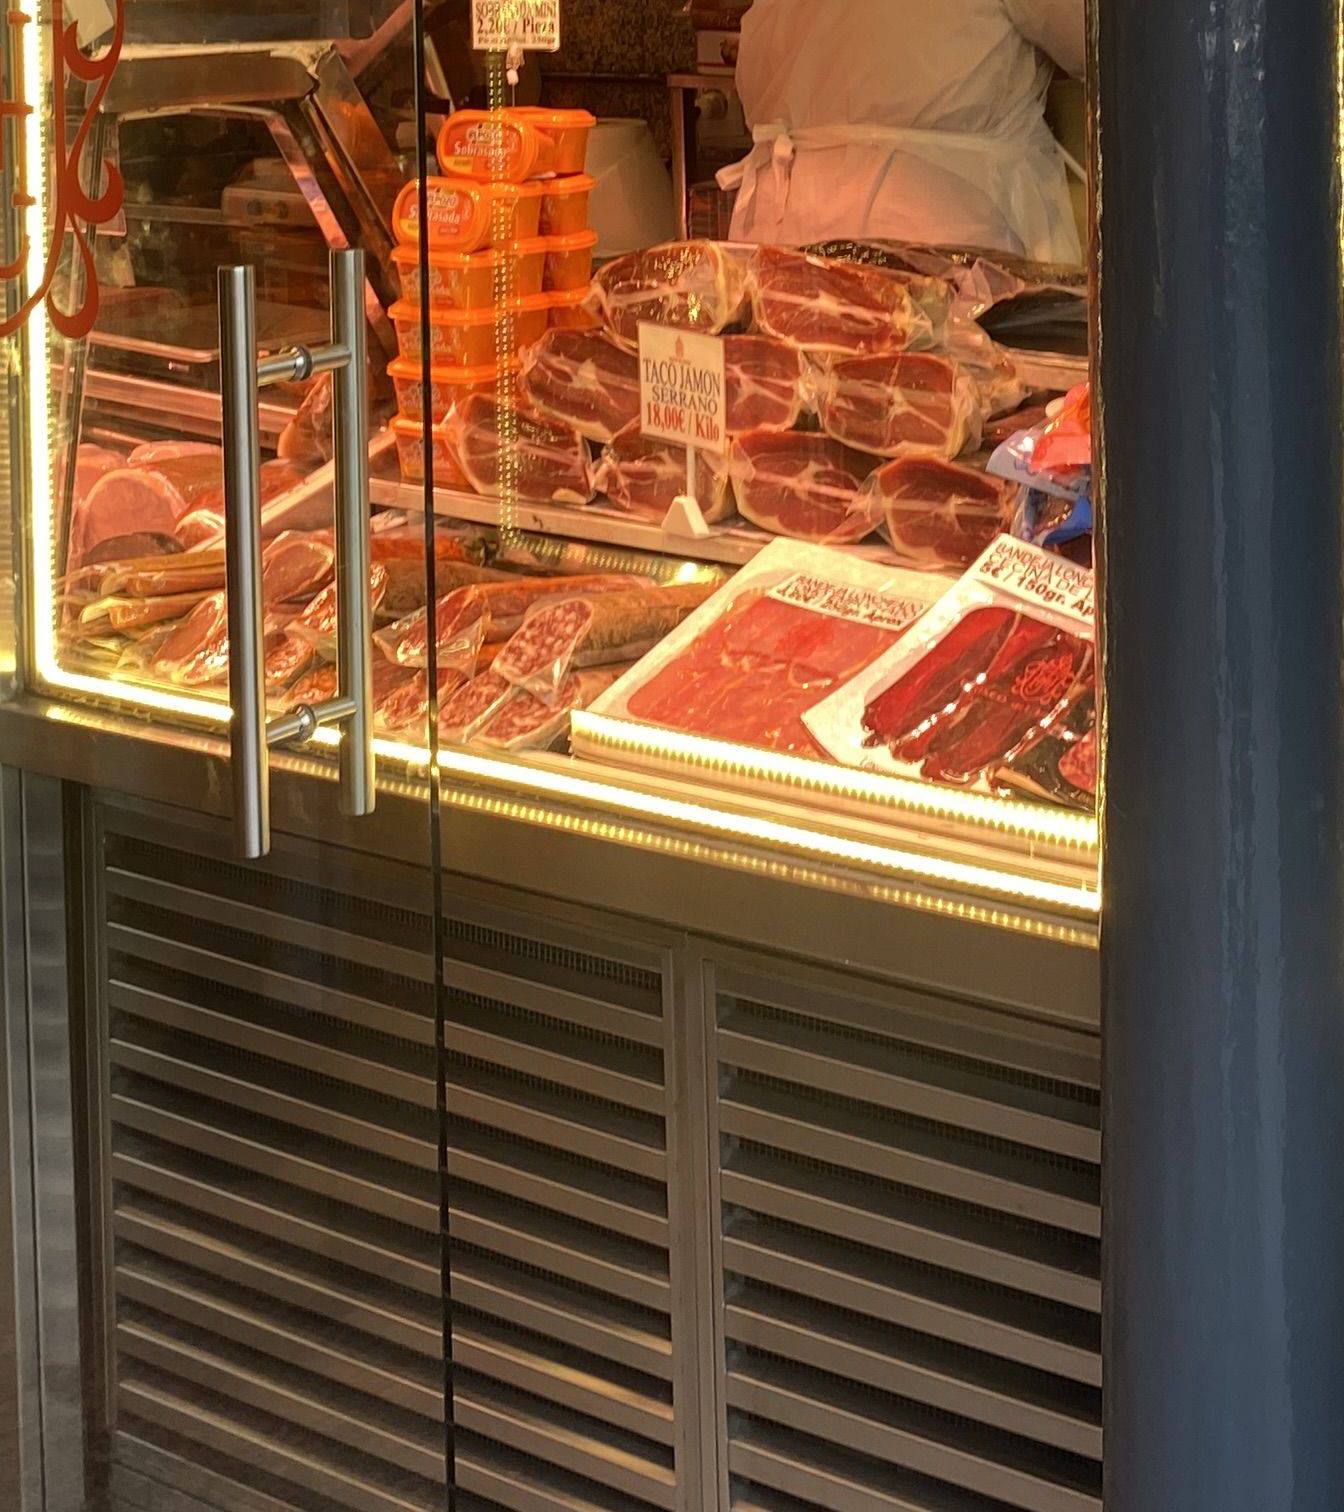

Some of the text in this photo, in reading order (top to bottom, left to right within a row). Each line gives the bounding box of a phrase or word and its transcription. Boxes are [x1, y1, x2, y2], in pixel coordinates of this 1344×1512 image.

[643, 357, 721, 397] TACO JAMON
[652, 385, 718, 416] SERRANO
[647, 402, 686, 433] 18,00€
[695, 412, 720, 442] Kilo
[988, 552, 1053, 585] CECINA
[995, 543, 1054, 576] BANDEJA
